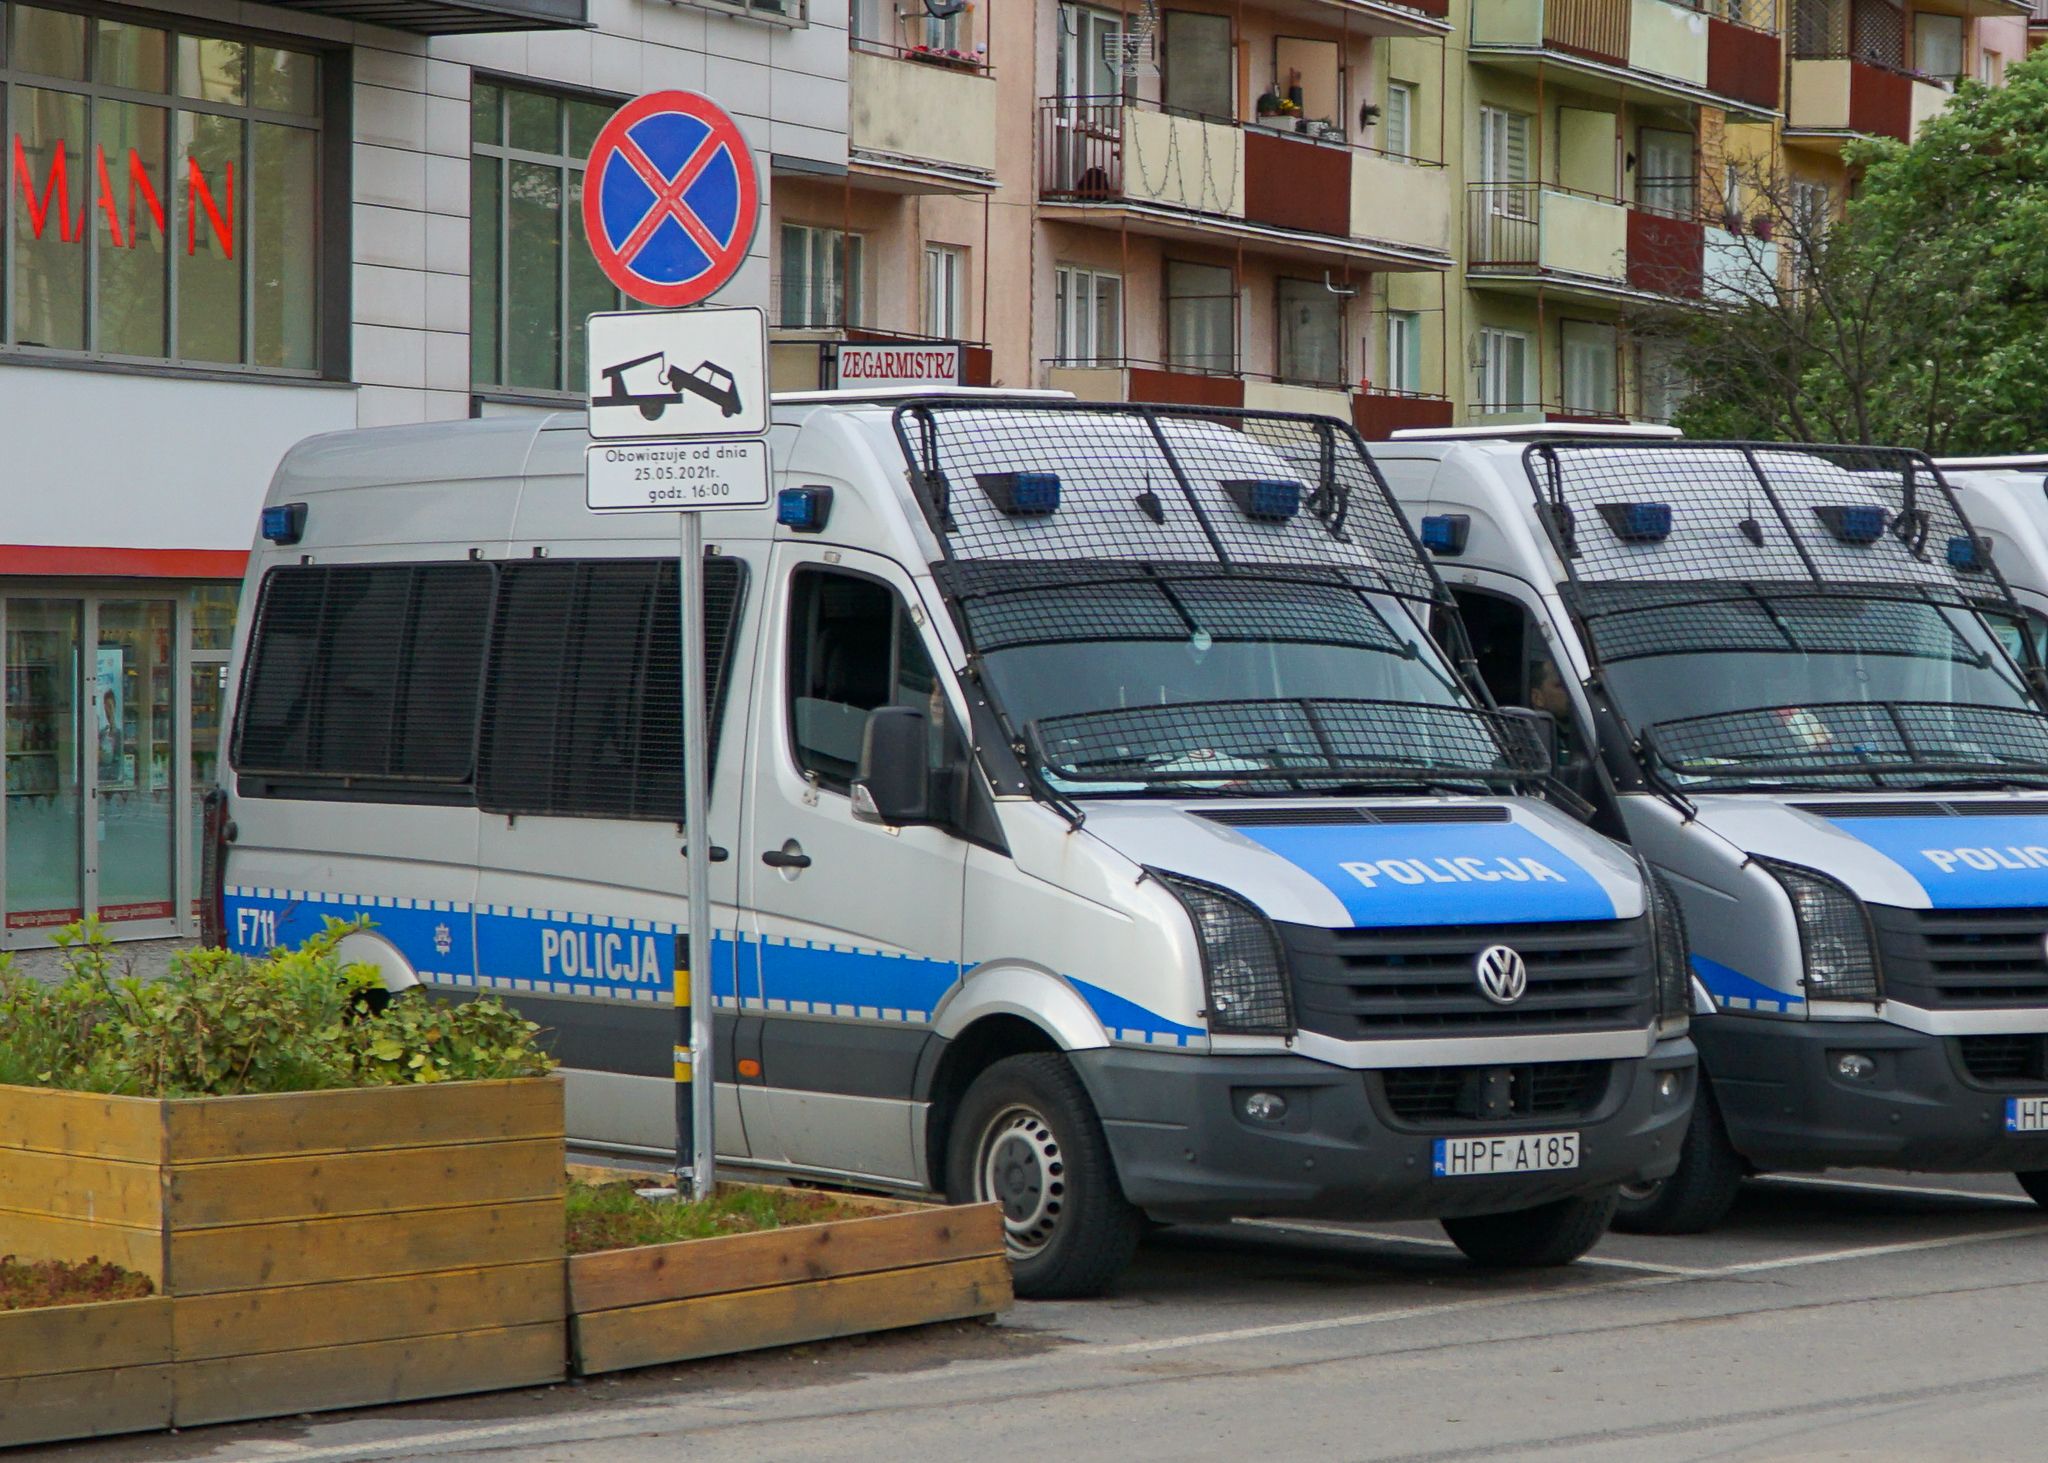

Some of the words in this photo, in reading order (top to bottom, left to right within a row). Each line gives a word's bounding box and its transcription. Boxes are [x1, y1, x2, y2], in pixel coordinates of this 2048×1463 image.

[14, 132, 234, 261] MANN
[842, 351, 956, 379] ZEGARMISTRZ
[605, 448, 686, 464] Obowiązuje
[692, 447, 710, 460] od
[716, 445, 748, 459] dnia
[634, 466, 720, 481] 25.05.2021r.
[648, 486, 687, 503] godz.
[692, 483, 730, 498] 16:00
[1338, 857, 1568, 888] POLICJA
[236, 910, 277, 948] F711
[541, 928, 661, 984] POLICJA
[1452, 1140, 1505, 1174] HPF
[1515, 1136, 1575, 1170] A185
